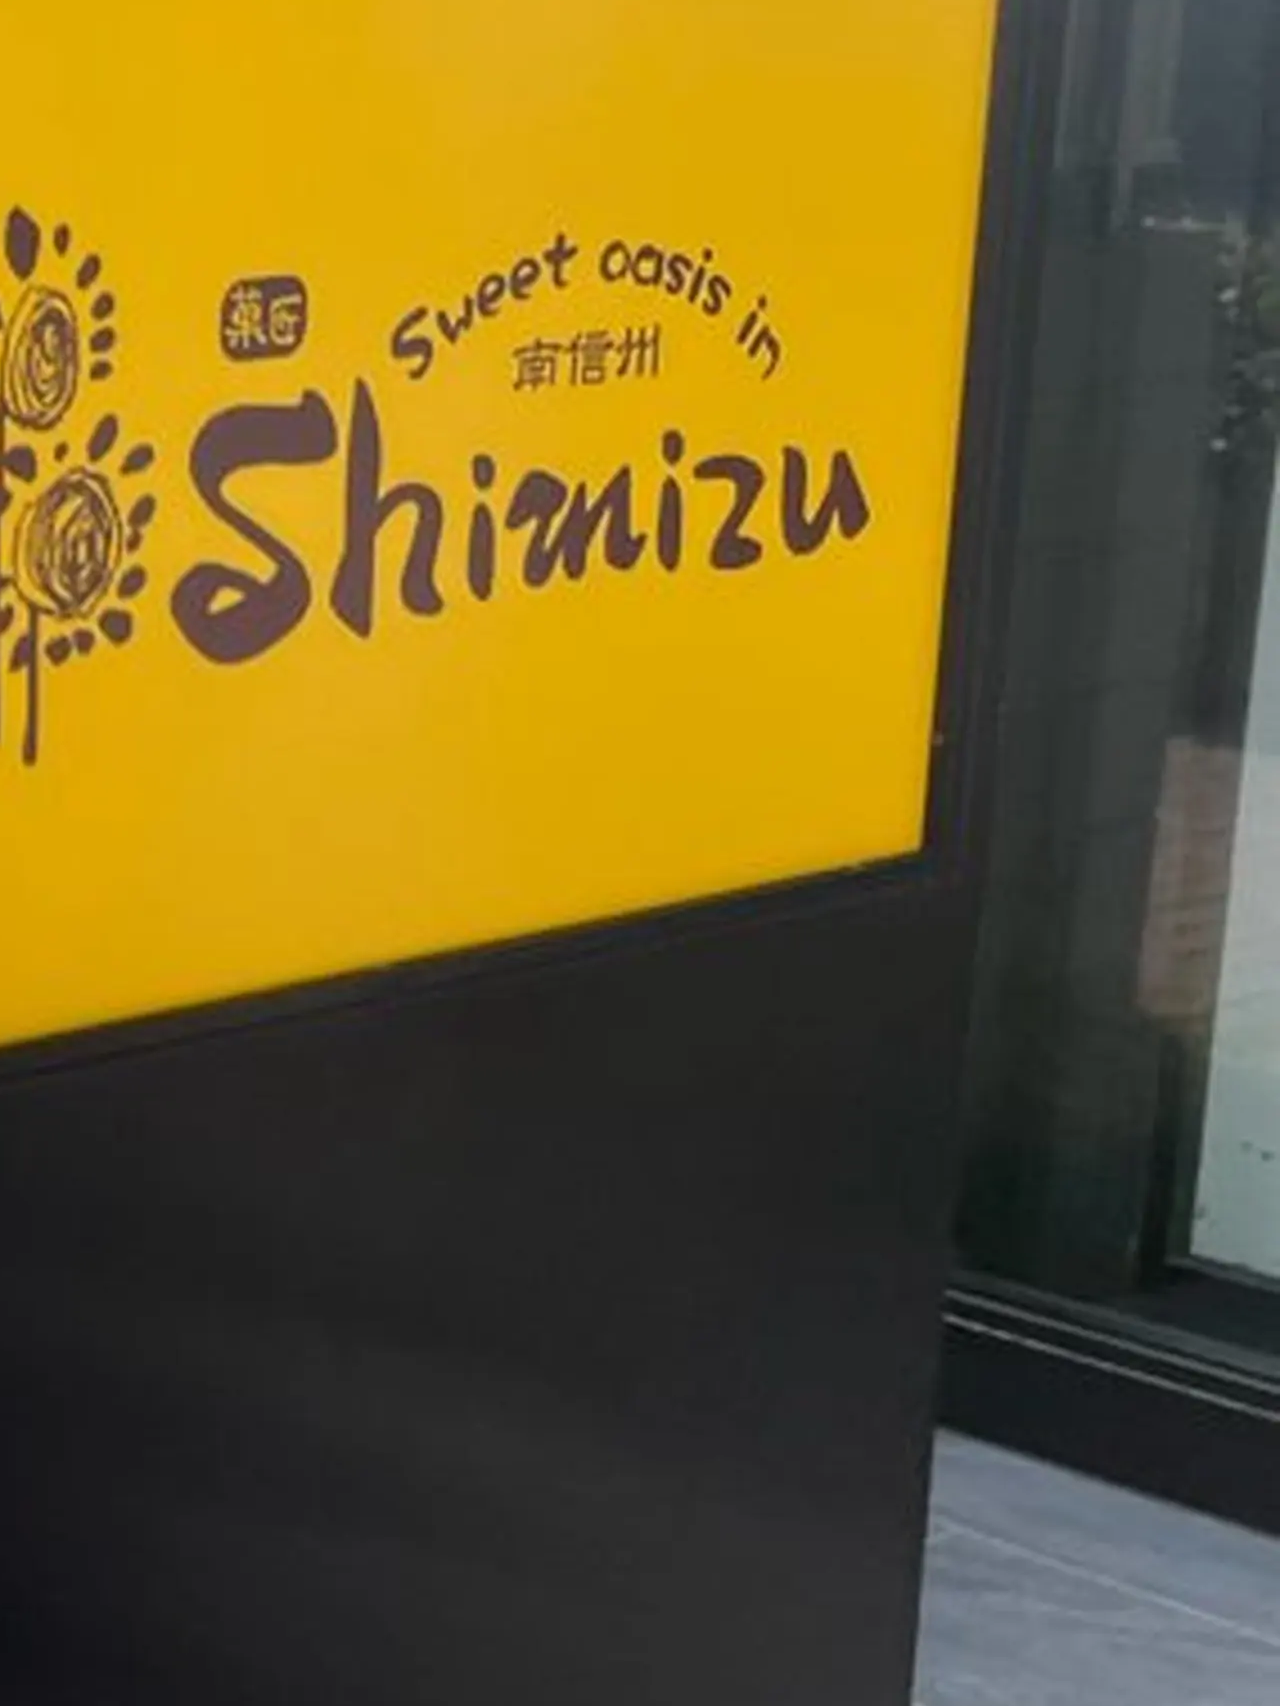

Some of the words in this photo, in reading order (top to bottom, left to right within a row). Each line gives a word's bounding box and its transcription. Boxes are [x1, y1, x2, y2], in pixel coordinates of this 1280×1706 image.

[390, 232, 578, 381] Sweet
[598, 239, 732, 317] oasis
[735, 294, 782, 382] in
[511, 323, 663, 392] 南信州
[170, 376, 872, 664] Shimizu
